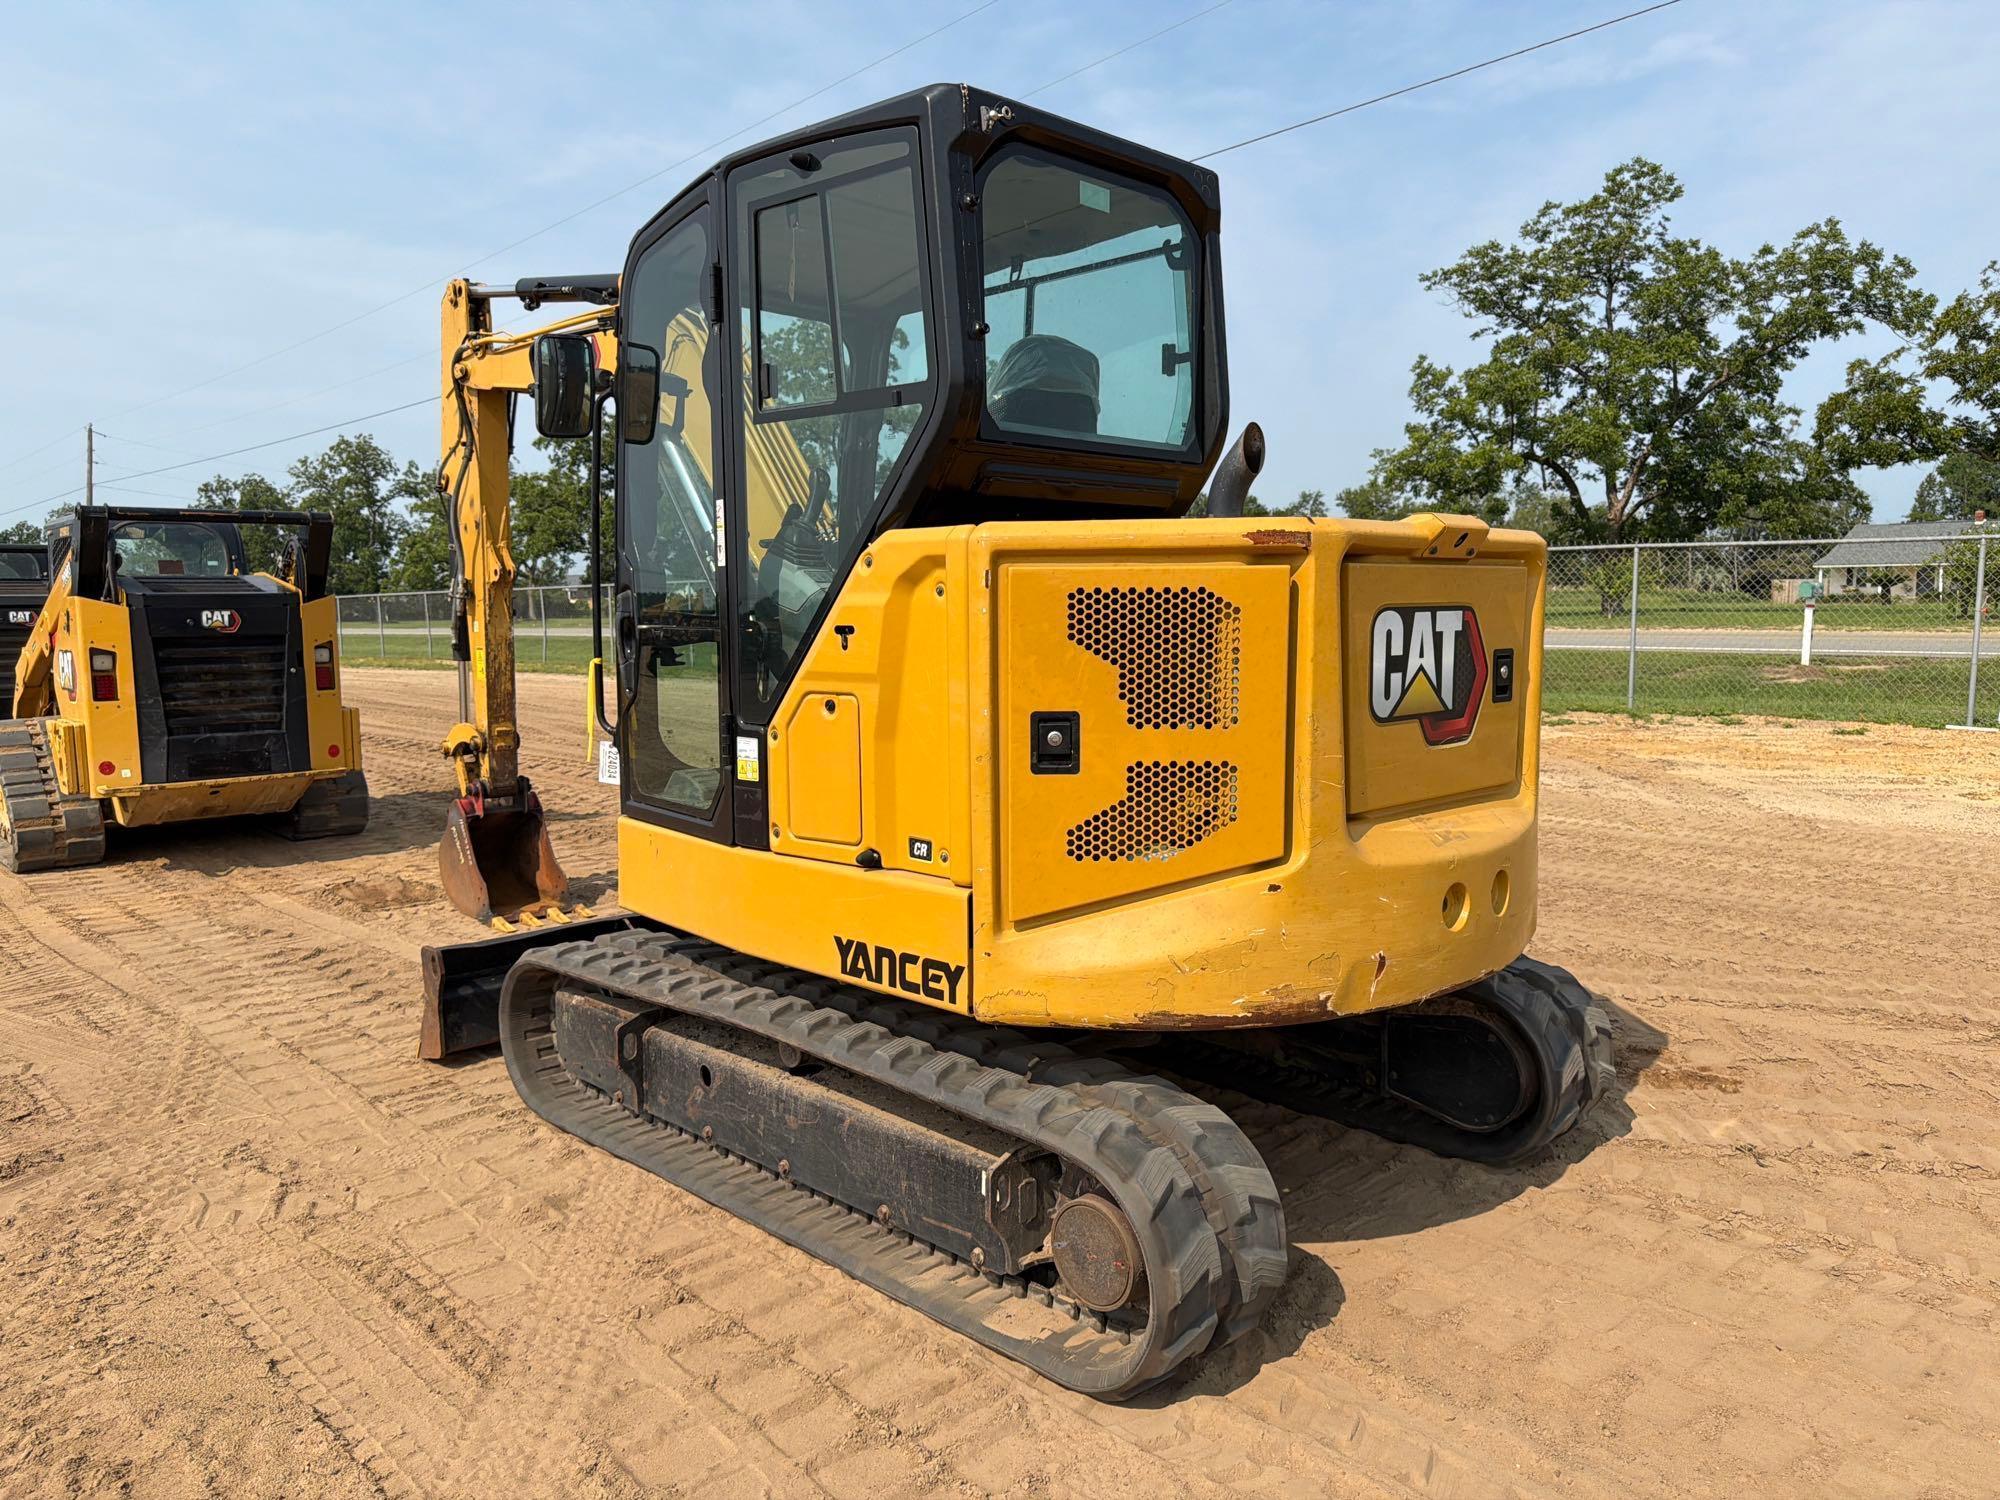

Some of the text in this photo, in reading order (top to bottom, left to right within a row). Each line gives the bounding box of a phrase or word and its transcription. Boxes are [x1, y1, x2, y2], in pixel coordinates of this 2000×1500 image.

[9, 611, 31, 623] CAT
[202, 610, 231, 627] CAT
[58, 651, 73, 690] CAT
[1372, 610, 1463, 718] CAT
[913, 842, 928, 857] CR
[833, 935, 966, 1004] YANCEY
